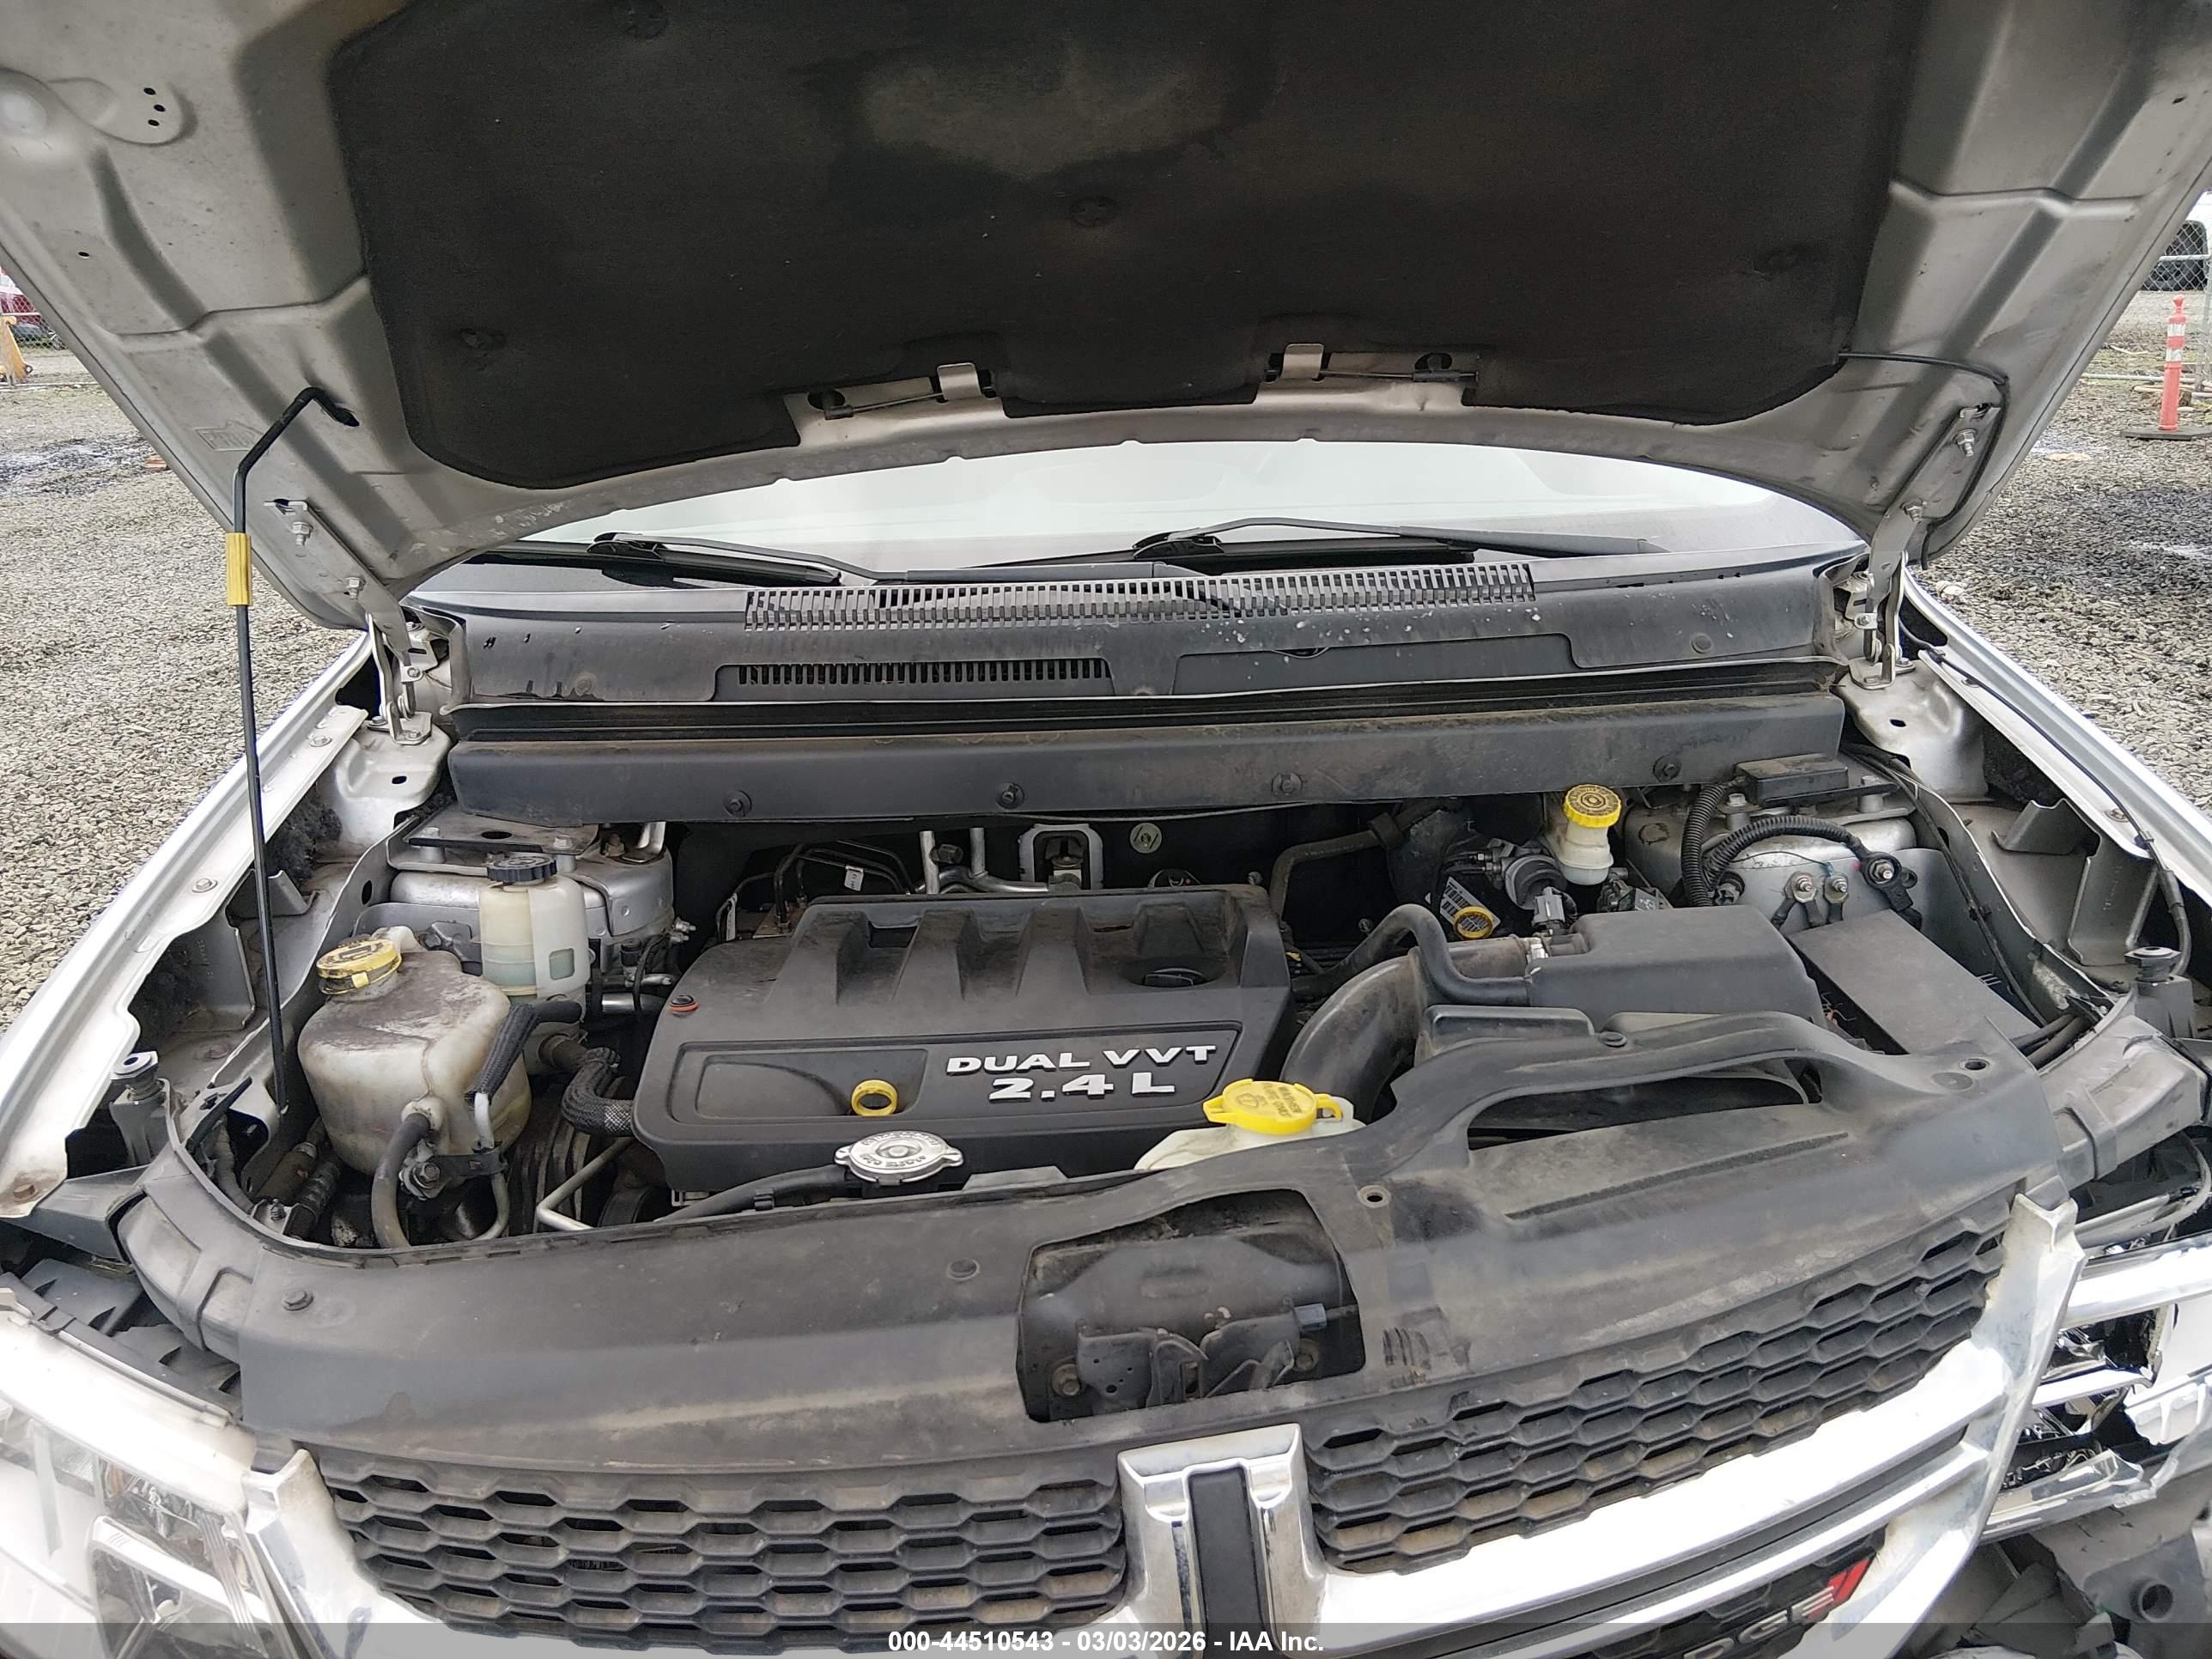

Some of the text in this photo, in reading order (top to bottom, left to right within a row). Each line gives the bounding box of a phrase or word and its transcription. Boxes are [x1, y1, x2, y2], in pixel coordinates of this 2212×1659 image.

[946, 1045, 1217, 1074] DUAL VVT
[988, 1072, 1176, 1102] 2.4 L
